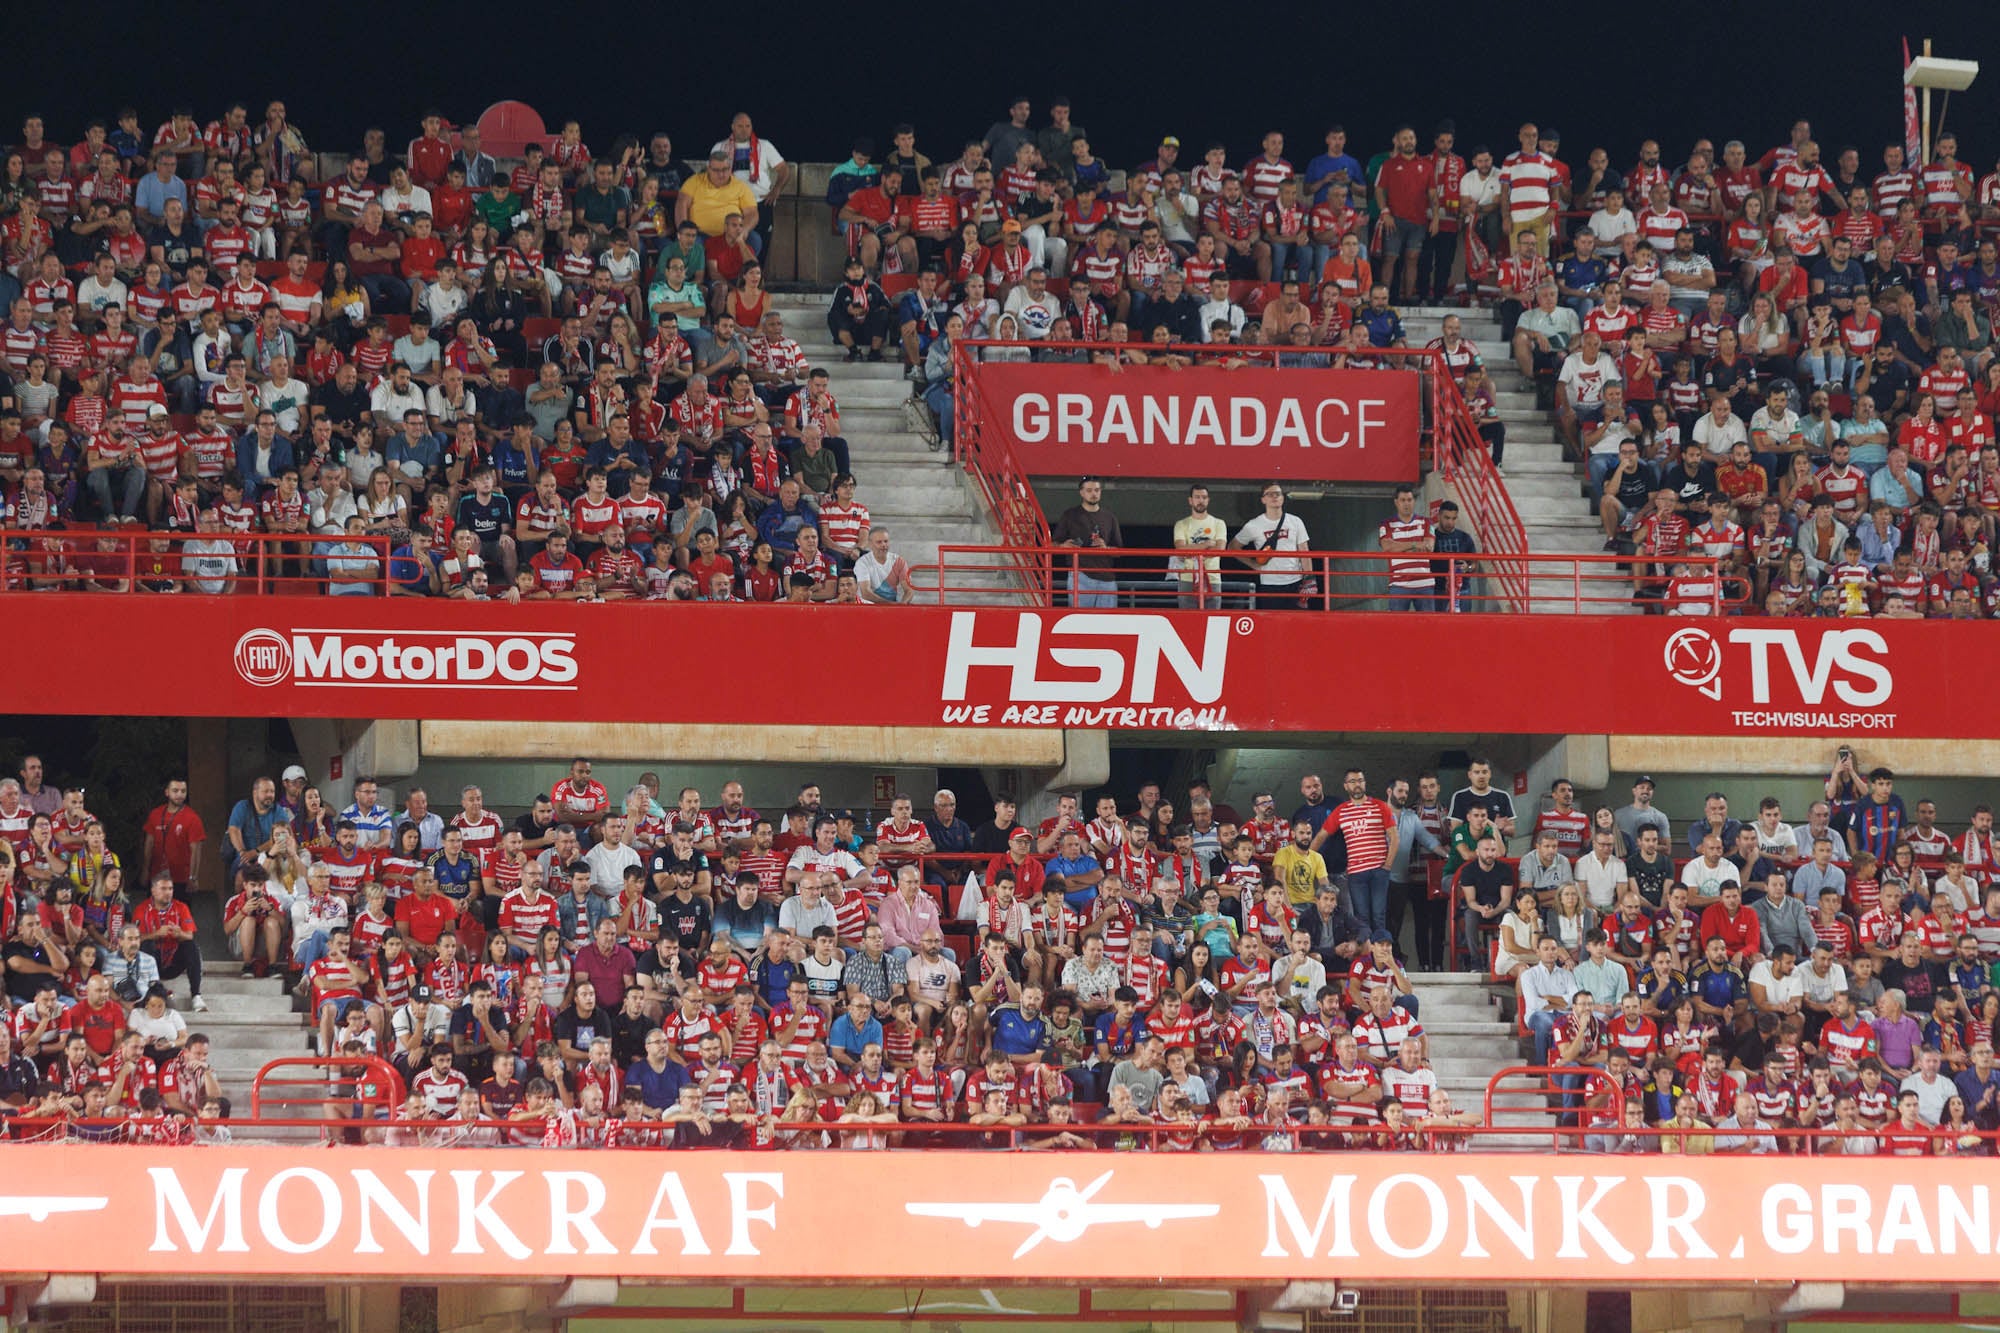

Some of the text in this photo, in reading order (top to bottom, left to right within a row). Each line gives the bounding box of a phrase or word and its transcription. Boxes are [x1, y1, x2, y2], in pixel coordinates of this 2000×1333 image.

[249, 646, 279, 670] FIAT
[293, 636, 579, 682] MotorDOS
[942, 612, 1231, 704] HSN
[1729, 629, 1893, 707] TVS
[943, 705, 991, 724] WE
[1001, 705, 1060, 724] ARE
[1732, 711, 1896, 729] TECHVISUALSPORT
[147, 1166, 785, 1260] MONKRAF
[1760, 1182, 2000, 1256] GRAN
